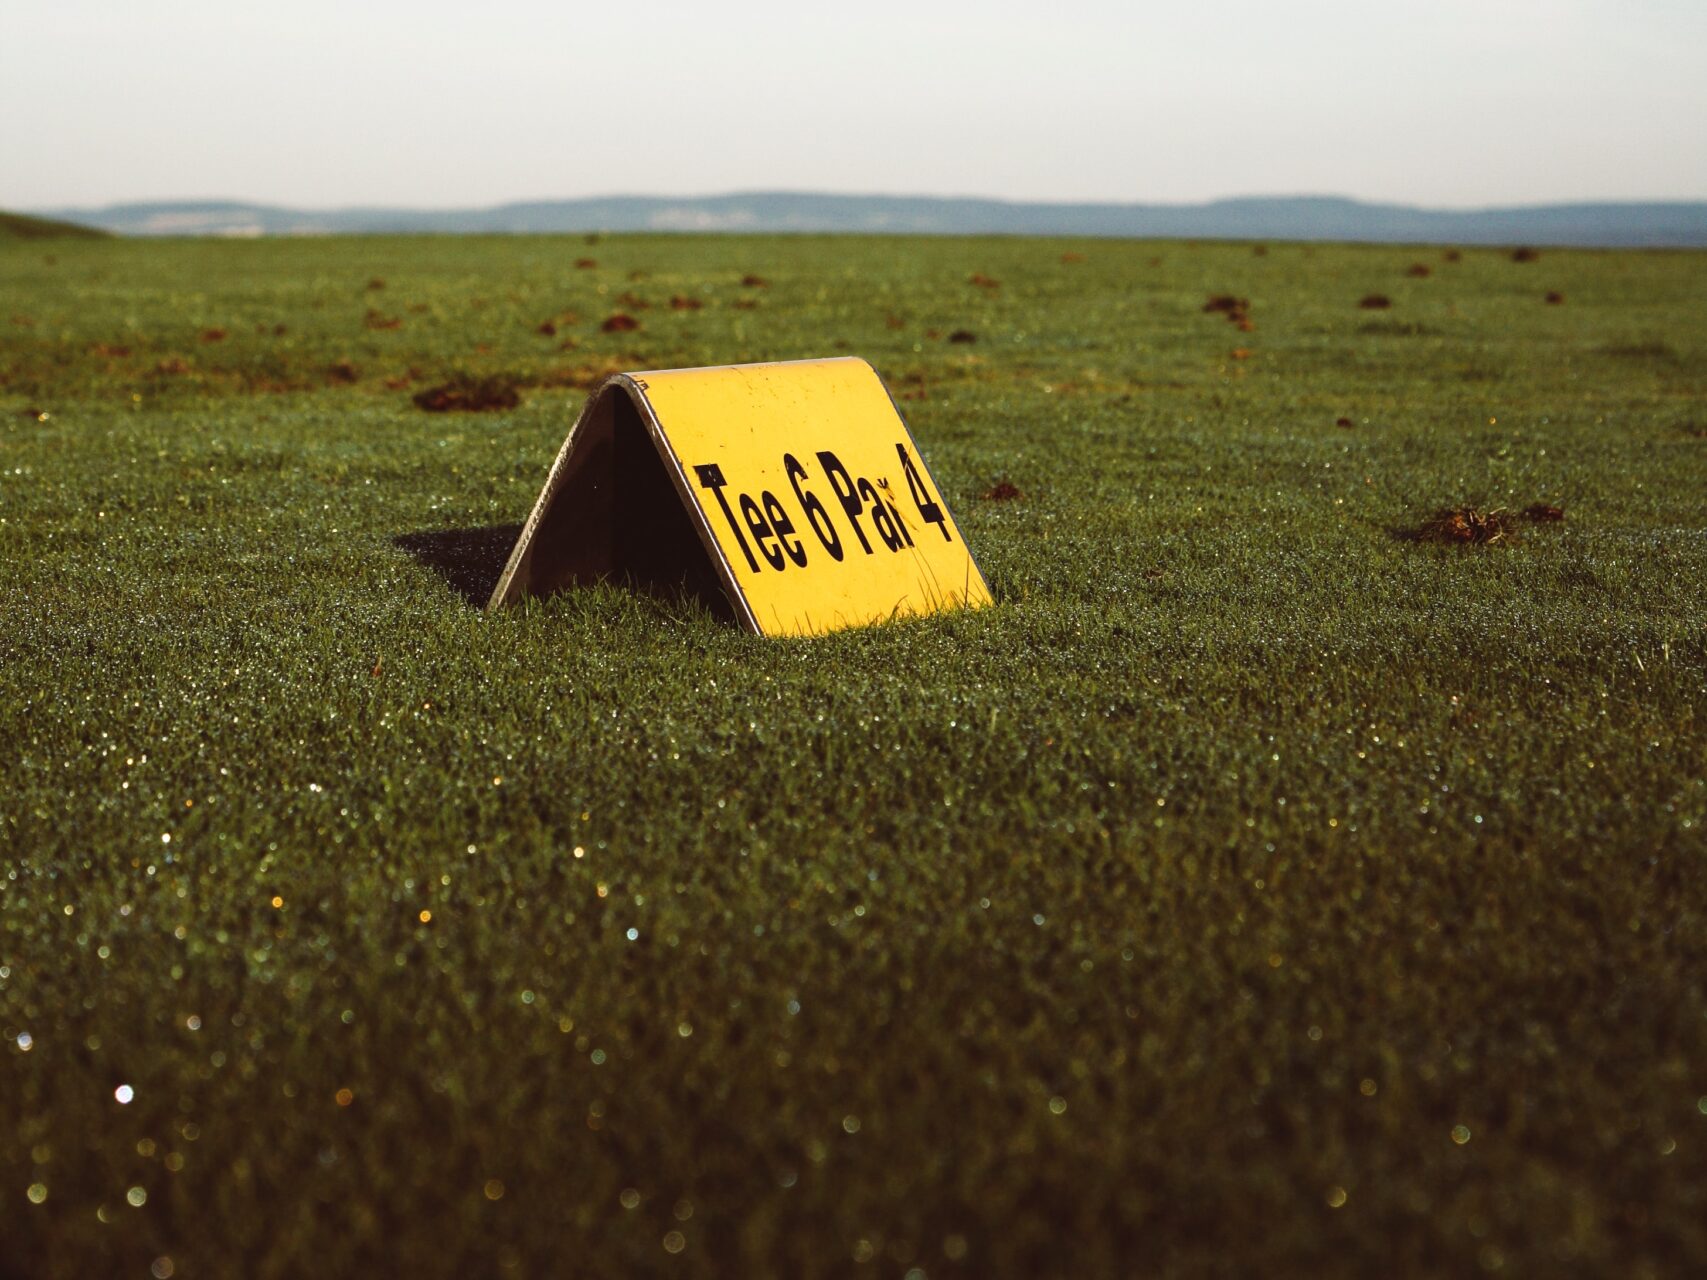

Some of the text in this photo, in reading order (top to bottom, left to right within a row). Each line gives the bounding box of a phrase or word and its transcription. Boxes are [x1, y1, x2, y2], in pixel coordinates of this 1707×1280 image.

[693, 443, 952, 573] Tee 6 Par 4
